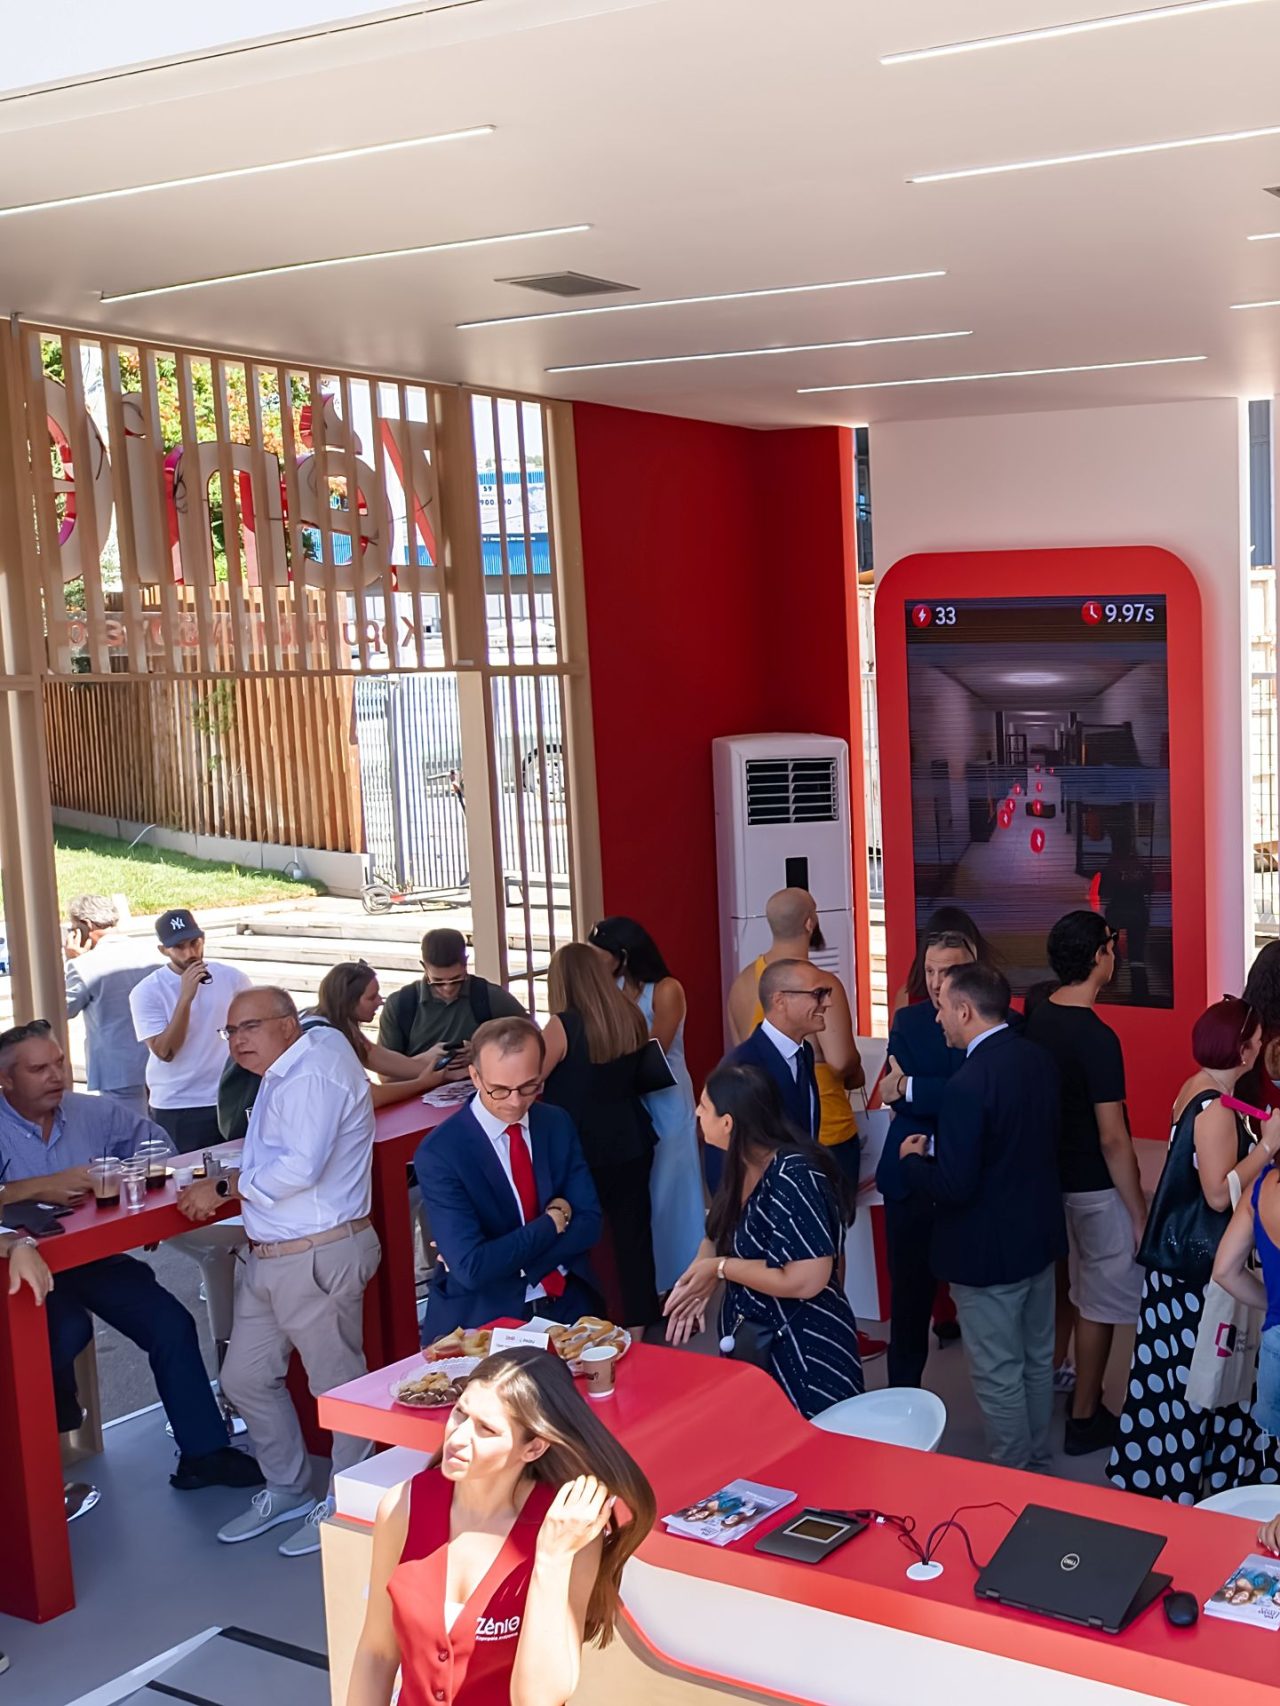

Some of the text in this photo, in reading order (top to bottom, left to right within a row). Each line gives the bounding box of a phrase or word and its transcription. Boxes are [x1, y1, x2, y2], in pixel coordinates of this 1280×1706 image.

[935, 607, 956, 625] 33
[1105, 604, 1155, 623] 9.97s
[170, 917, 186, 930] NY
